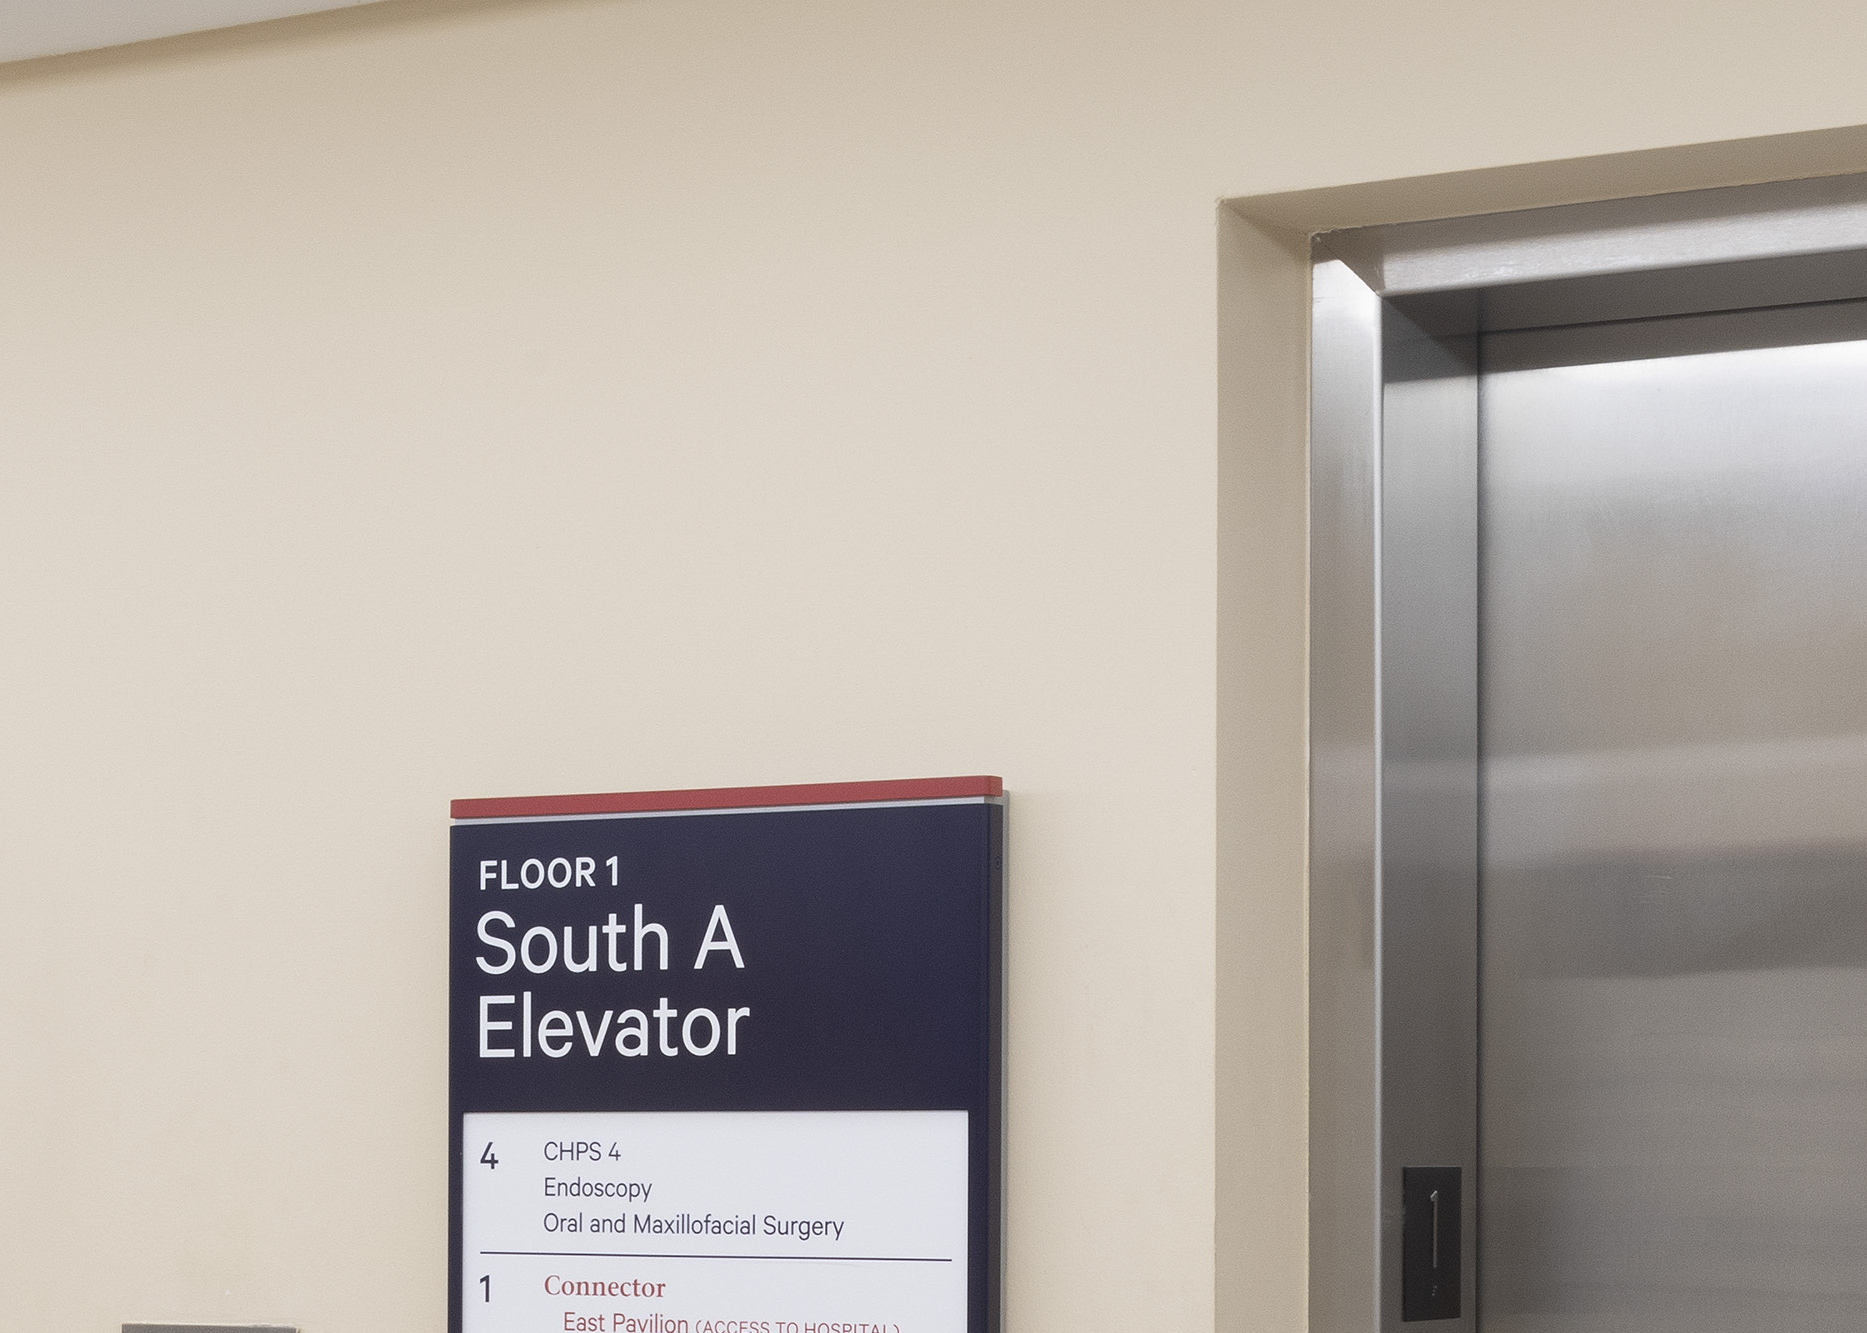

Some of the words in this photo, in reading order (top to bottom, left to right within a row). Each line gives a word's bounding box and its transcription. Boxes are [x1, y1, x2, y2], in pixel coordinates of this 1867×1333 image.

[479, 856, 596, 891] FLOOR
[605, 855, 618, 887] 1
[475, 903, 669, 975] South
[693, 904, 745, 970] A
[479, 990, 751, 1059] Elevator
[479, 1141, 499, 1170] 4
[543, 1141, 602, 1162] CHPS
[608, 1141, 622, 1162] 4
[544, 1176, 653, 1203] Endoscopy
[543, 1211, 583, 1233] Oral
[589, 1212, 626, 1234] and
[633, 1213, 756, 1236] Maxillofacial
[763, 1214, 845, 1241] Surgery
[1429, 1188, 1439, 1269] 1
[479, 1274, 490, 1303] 1
[544, 1274, 667, 1298] Connector
[564, 1311, 606, 1333] East
